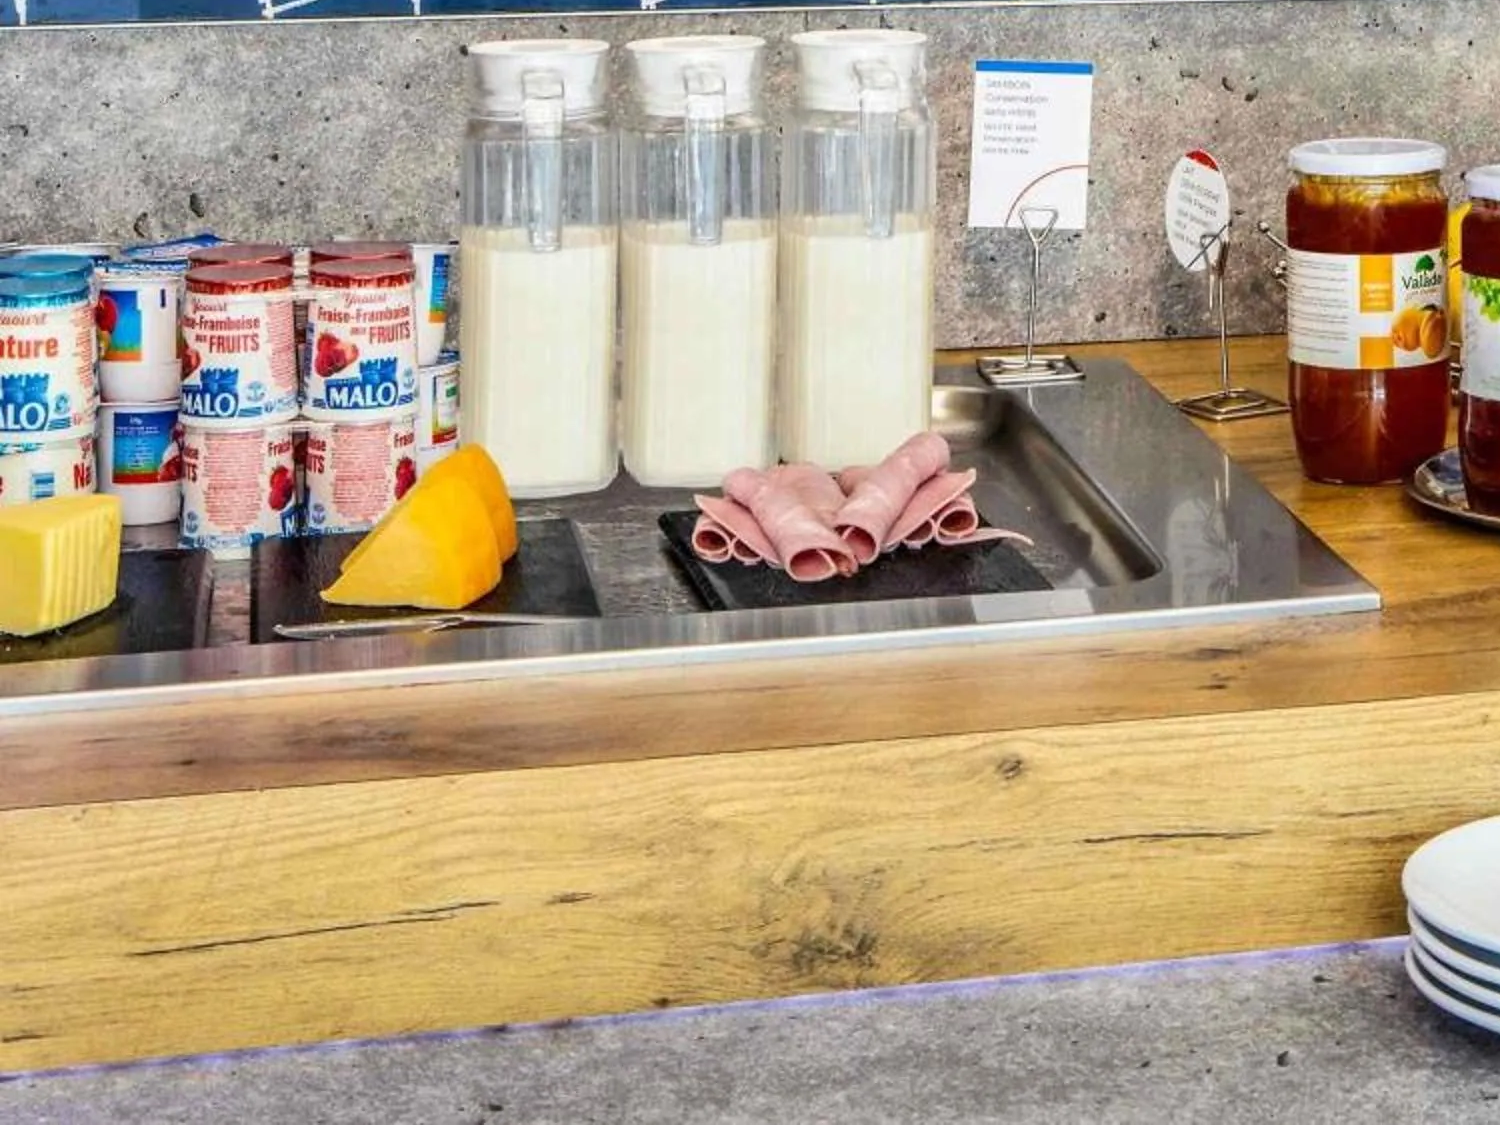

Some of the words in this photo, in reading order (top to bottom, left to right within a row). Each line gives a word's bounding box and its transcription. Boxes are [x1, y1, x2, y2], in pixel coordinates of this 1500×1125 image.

[0, 312, 47, 326] aourt
[209, 333, 260, 354] FRUITS
[369, 321, 411, 345] FRUITS
[329, 382, 396, 408] MALO
